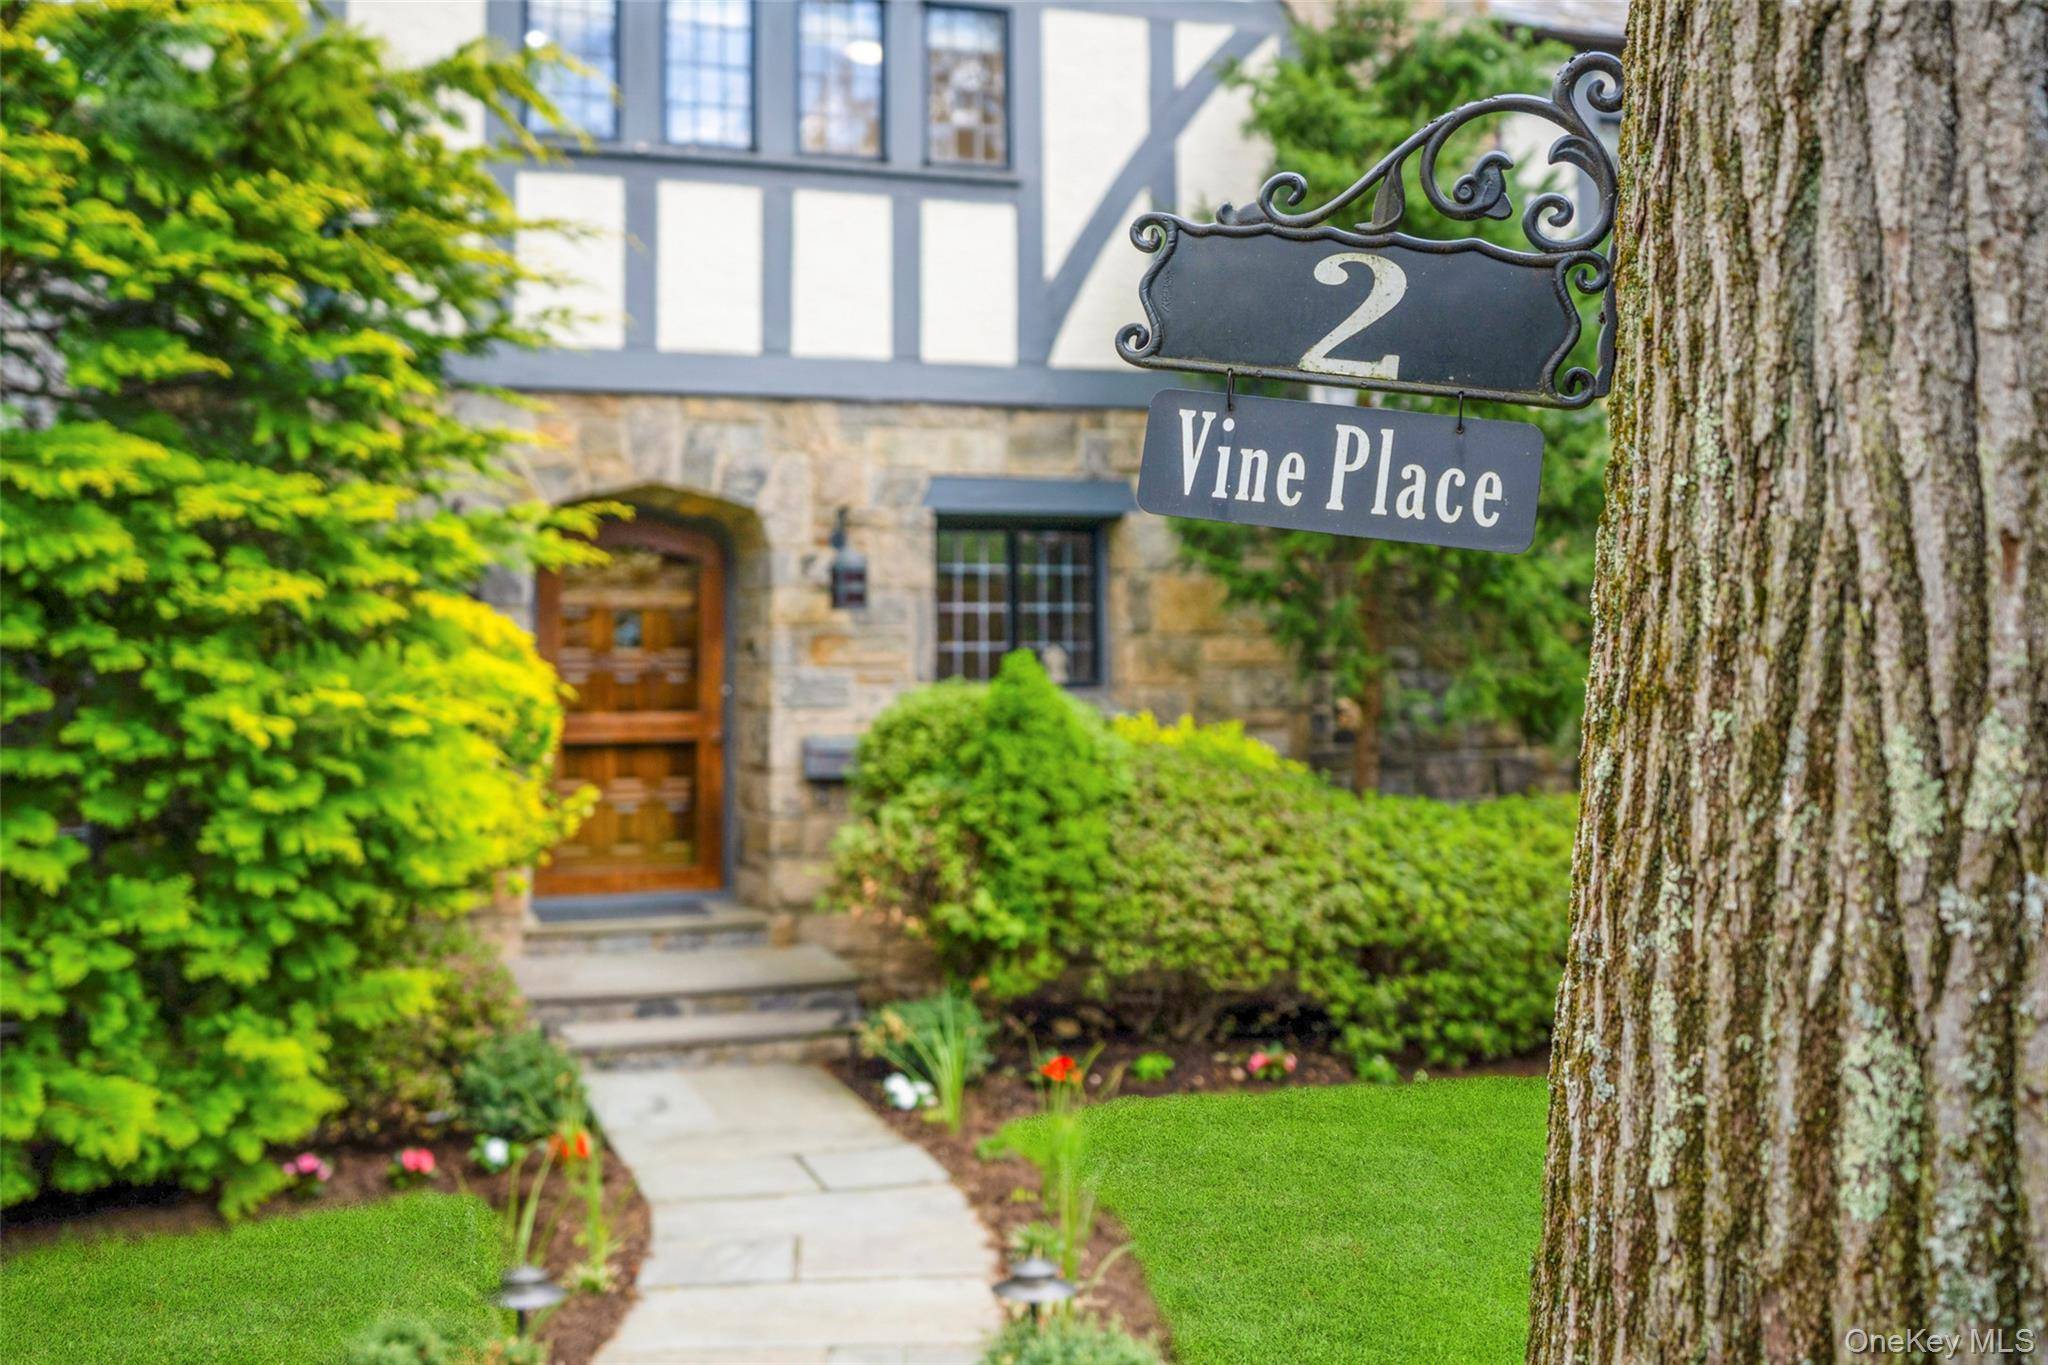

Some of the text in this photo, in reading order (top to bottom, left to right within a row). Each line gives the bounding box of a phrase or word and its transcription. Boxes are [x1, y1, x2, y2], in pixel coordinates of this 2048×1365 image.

[1299, 252, 1408, 380] 2
[1178, 409, 1504, 528] Vine Place
